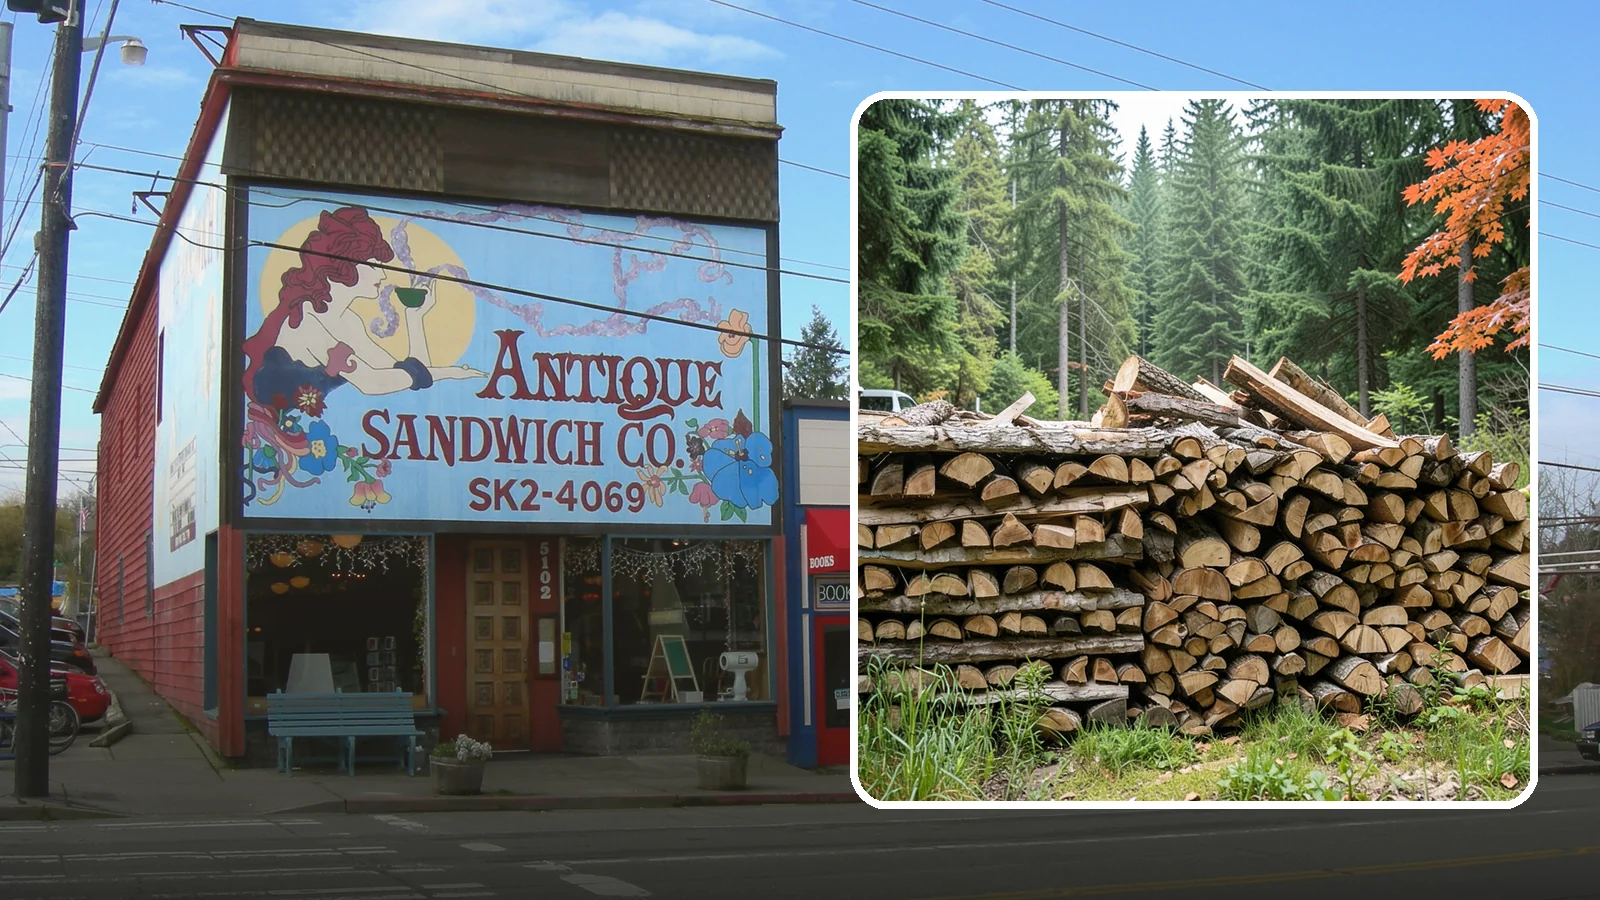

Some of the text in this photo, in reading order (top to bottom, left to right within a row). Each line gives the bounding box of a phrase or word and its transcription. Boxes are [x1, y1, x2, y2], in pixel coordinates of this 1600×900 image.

[476, 328, 724, 421] ANTIQUE
[361, 408, 685, 469] SANDWICH CO.
[468, 477, 645, 513] SK2-4069
[539, 541, 551, 600] 5102
[809, 554, 835, 569] BOOKS
